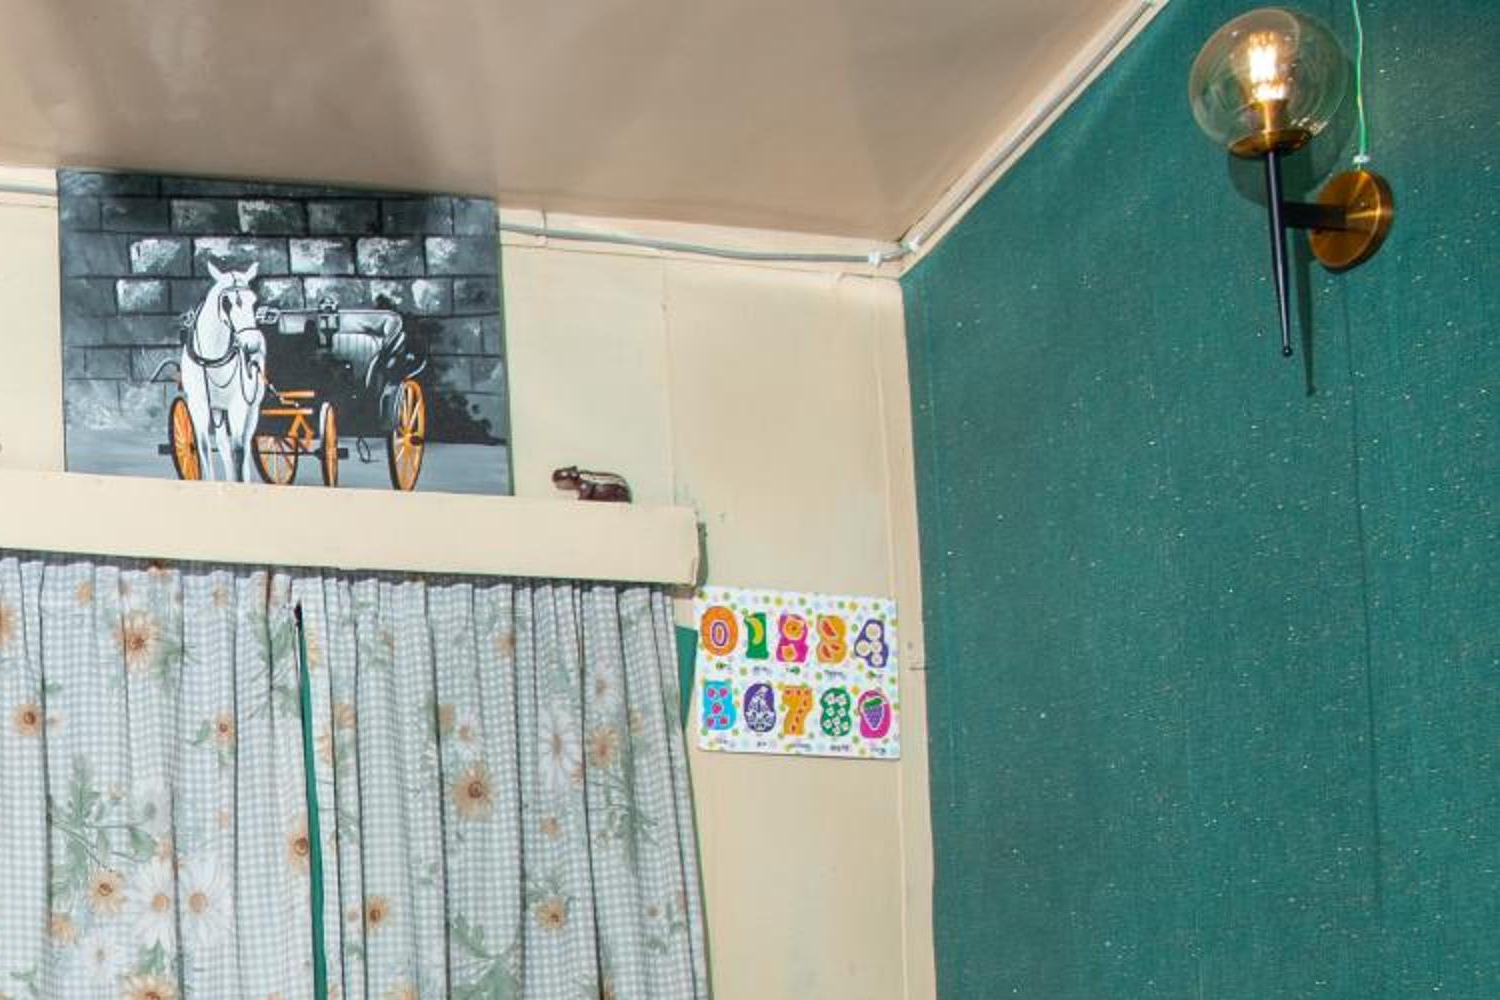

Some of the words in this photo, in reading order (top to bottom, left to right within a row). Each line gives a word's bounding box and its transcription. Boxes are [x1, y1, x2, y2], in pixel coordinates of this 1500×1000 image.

[701, 605, 739, 657] 0
[743, 611, 769, 660] 1
[854, 618, 889, 668] 4
[781, 684, 814, 736] 7
[819, 687, 852, 737] 8
